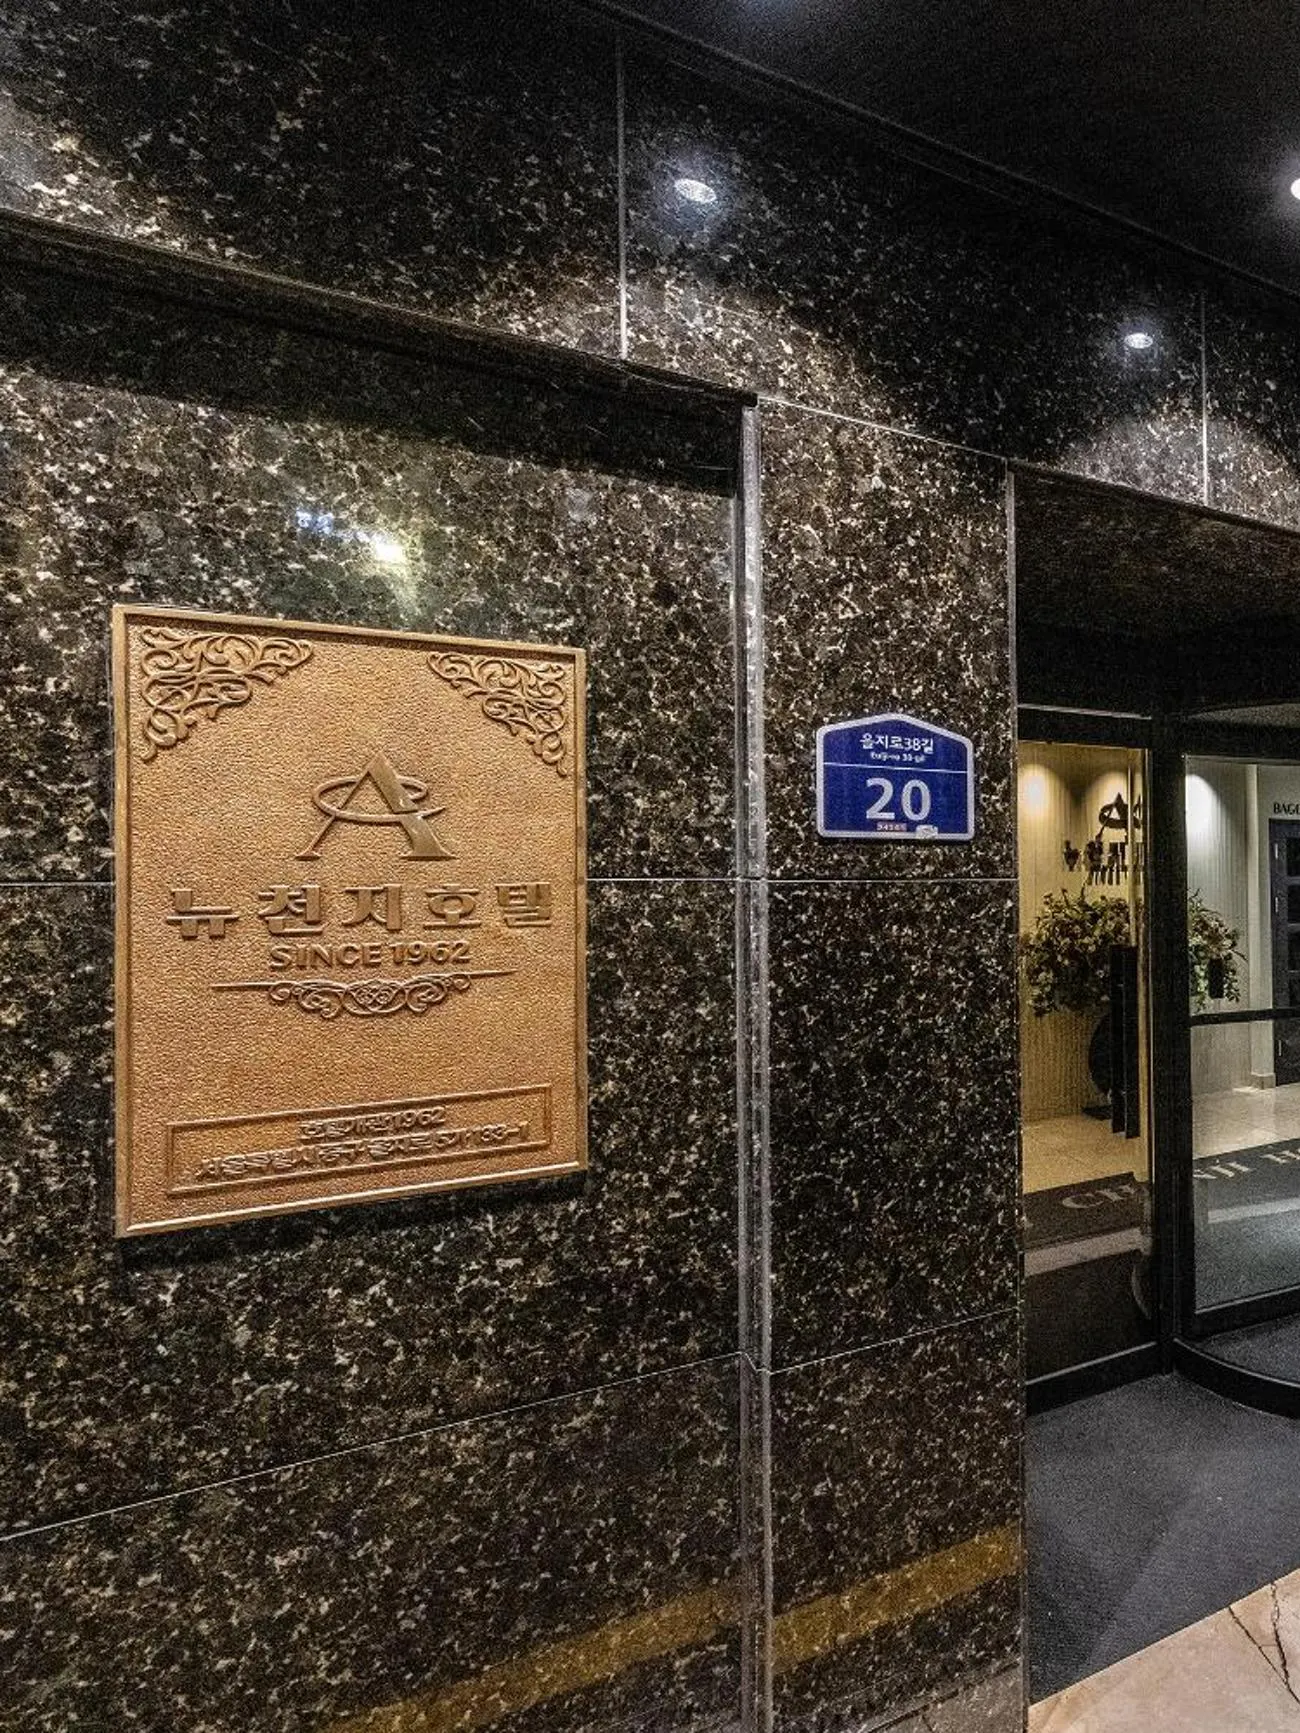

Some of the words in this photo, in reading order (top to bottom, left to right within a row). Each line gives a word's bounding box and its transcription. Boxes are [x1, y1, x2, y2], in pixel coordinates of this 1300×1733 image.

[860, 732, 934, 755] 을지로38길
[865, 777, 932, 822] 20
[166, 882, 553, 940] 뉴천지호텔
[269, 942, 382, 971] SINCE
[388, 939, 471, 967] 1962
